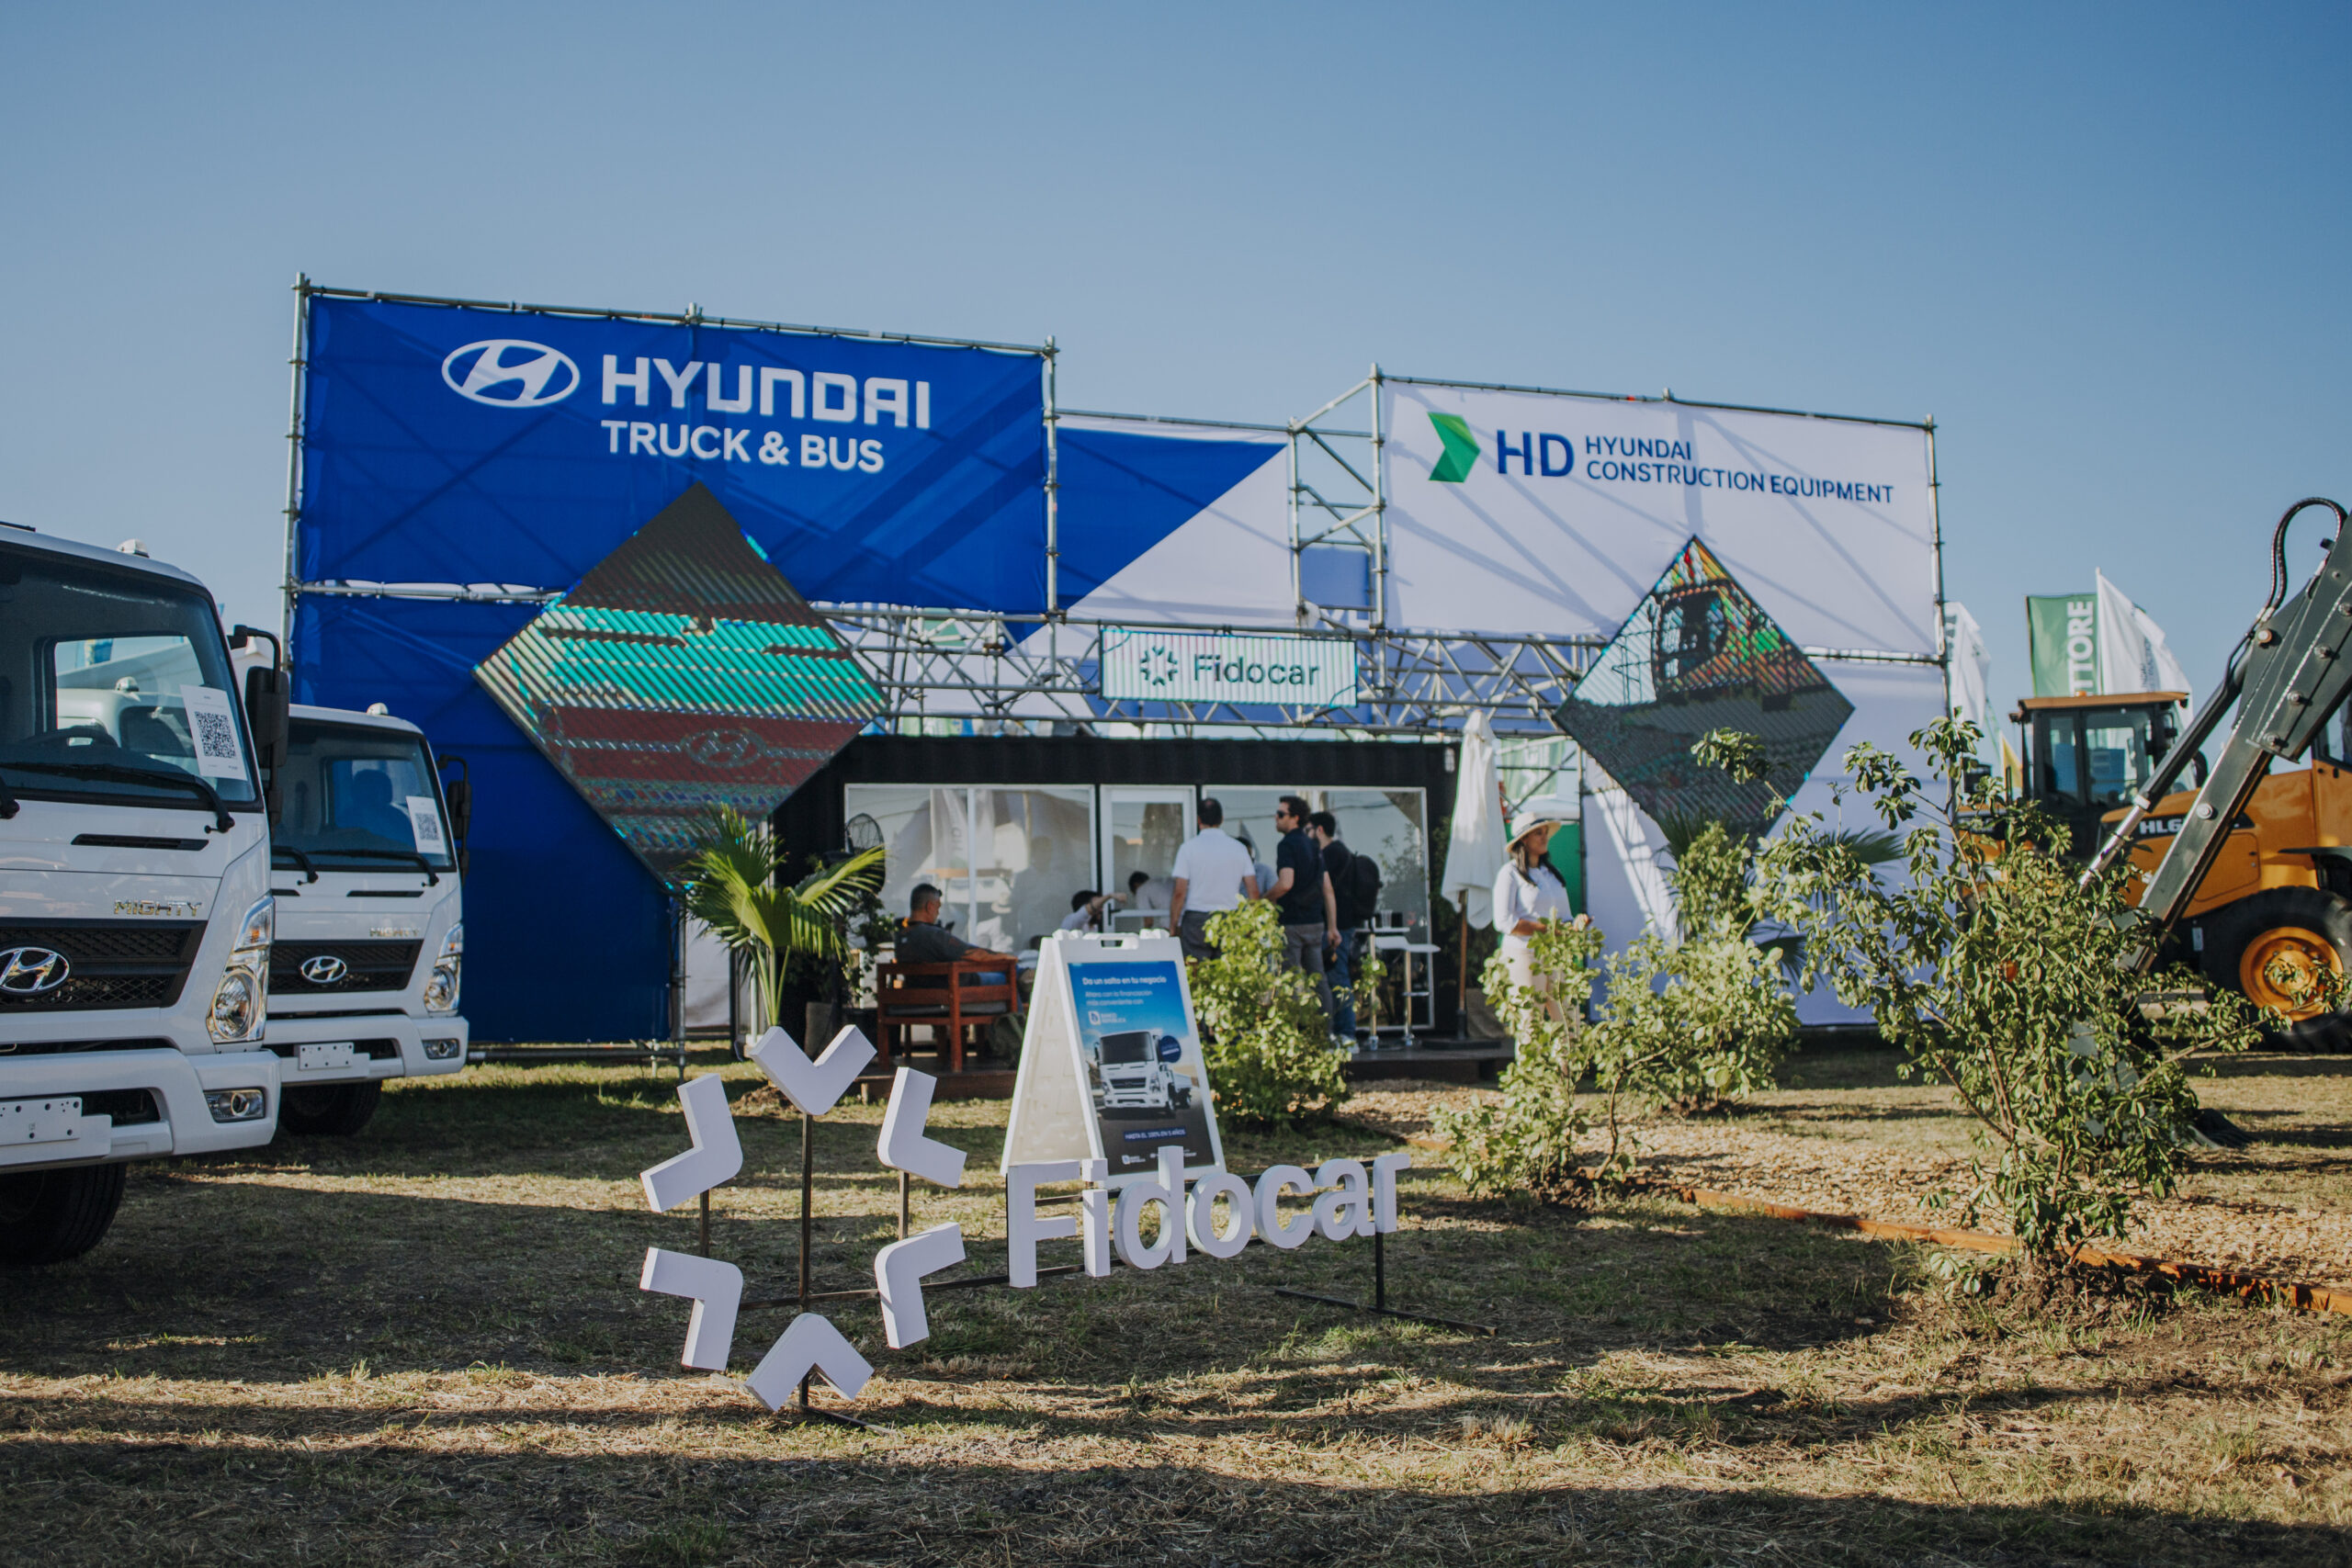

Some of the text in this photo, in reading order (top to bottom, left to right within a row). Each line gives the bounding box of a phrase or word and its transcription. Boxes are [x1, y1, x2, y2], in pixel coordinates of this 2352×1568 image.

[602, 354, 930, 429] HYUNDAI
[601, 420, 884, 473] TRUCK & BUS
[1497, 429, 1575, 478] HD
[1586, 435, 1691, 460] HYUNDAI
[1587, 461, 1894, 503] CONSTRUCTION EQUIPMENT
[1194, 655, 1320, 685] Fidocar
[2067, 601, 2094, 696] TTORE
[114, 899, 202, 917] MIGHTY
[1139, 976, 1167, 986] negocio
[1008, 1145, 1411, 1288] Fidocar
